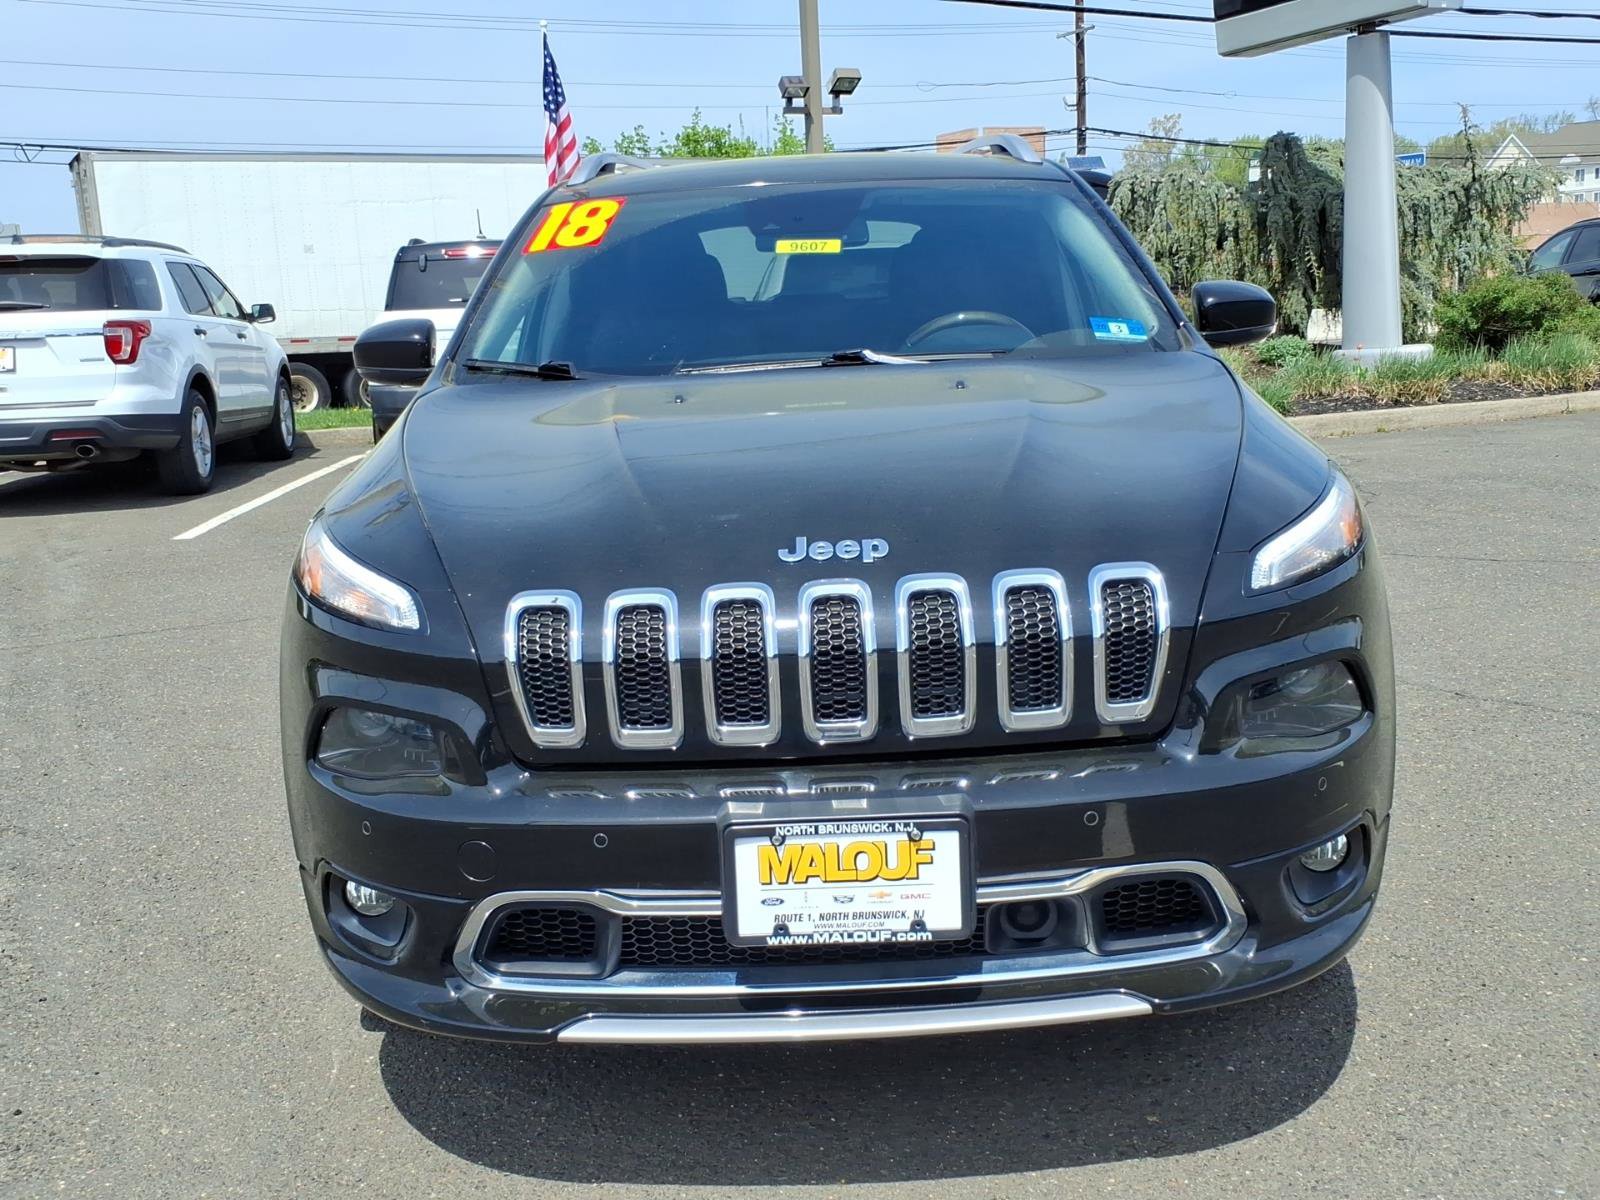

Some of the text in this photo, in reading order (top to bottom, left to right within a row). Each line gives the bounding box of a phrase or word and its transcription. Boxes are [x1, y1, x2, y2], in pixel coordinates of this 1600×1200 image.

[528, 199, 620, 253] 18
[790, 241, 828, 252] 9607
[778, 536, 889, 563] Jeep
[775, 824, 815, 836] NORTH
[818, 823, 893, 835] BRUNSWICK,
[757, 839, 936, 885] MALOUF
[774, 913, 804, 924] ROUTE
[819, 911, 850, 922] NORTH
[852, 910, 910, 921] BRUNSWICK,
[914, 909, 925, 920] NJ
[813, 921, 885, 930] WWW.MALOUF.COM
[766, 931, 932, 946] www.MALOUF.com
